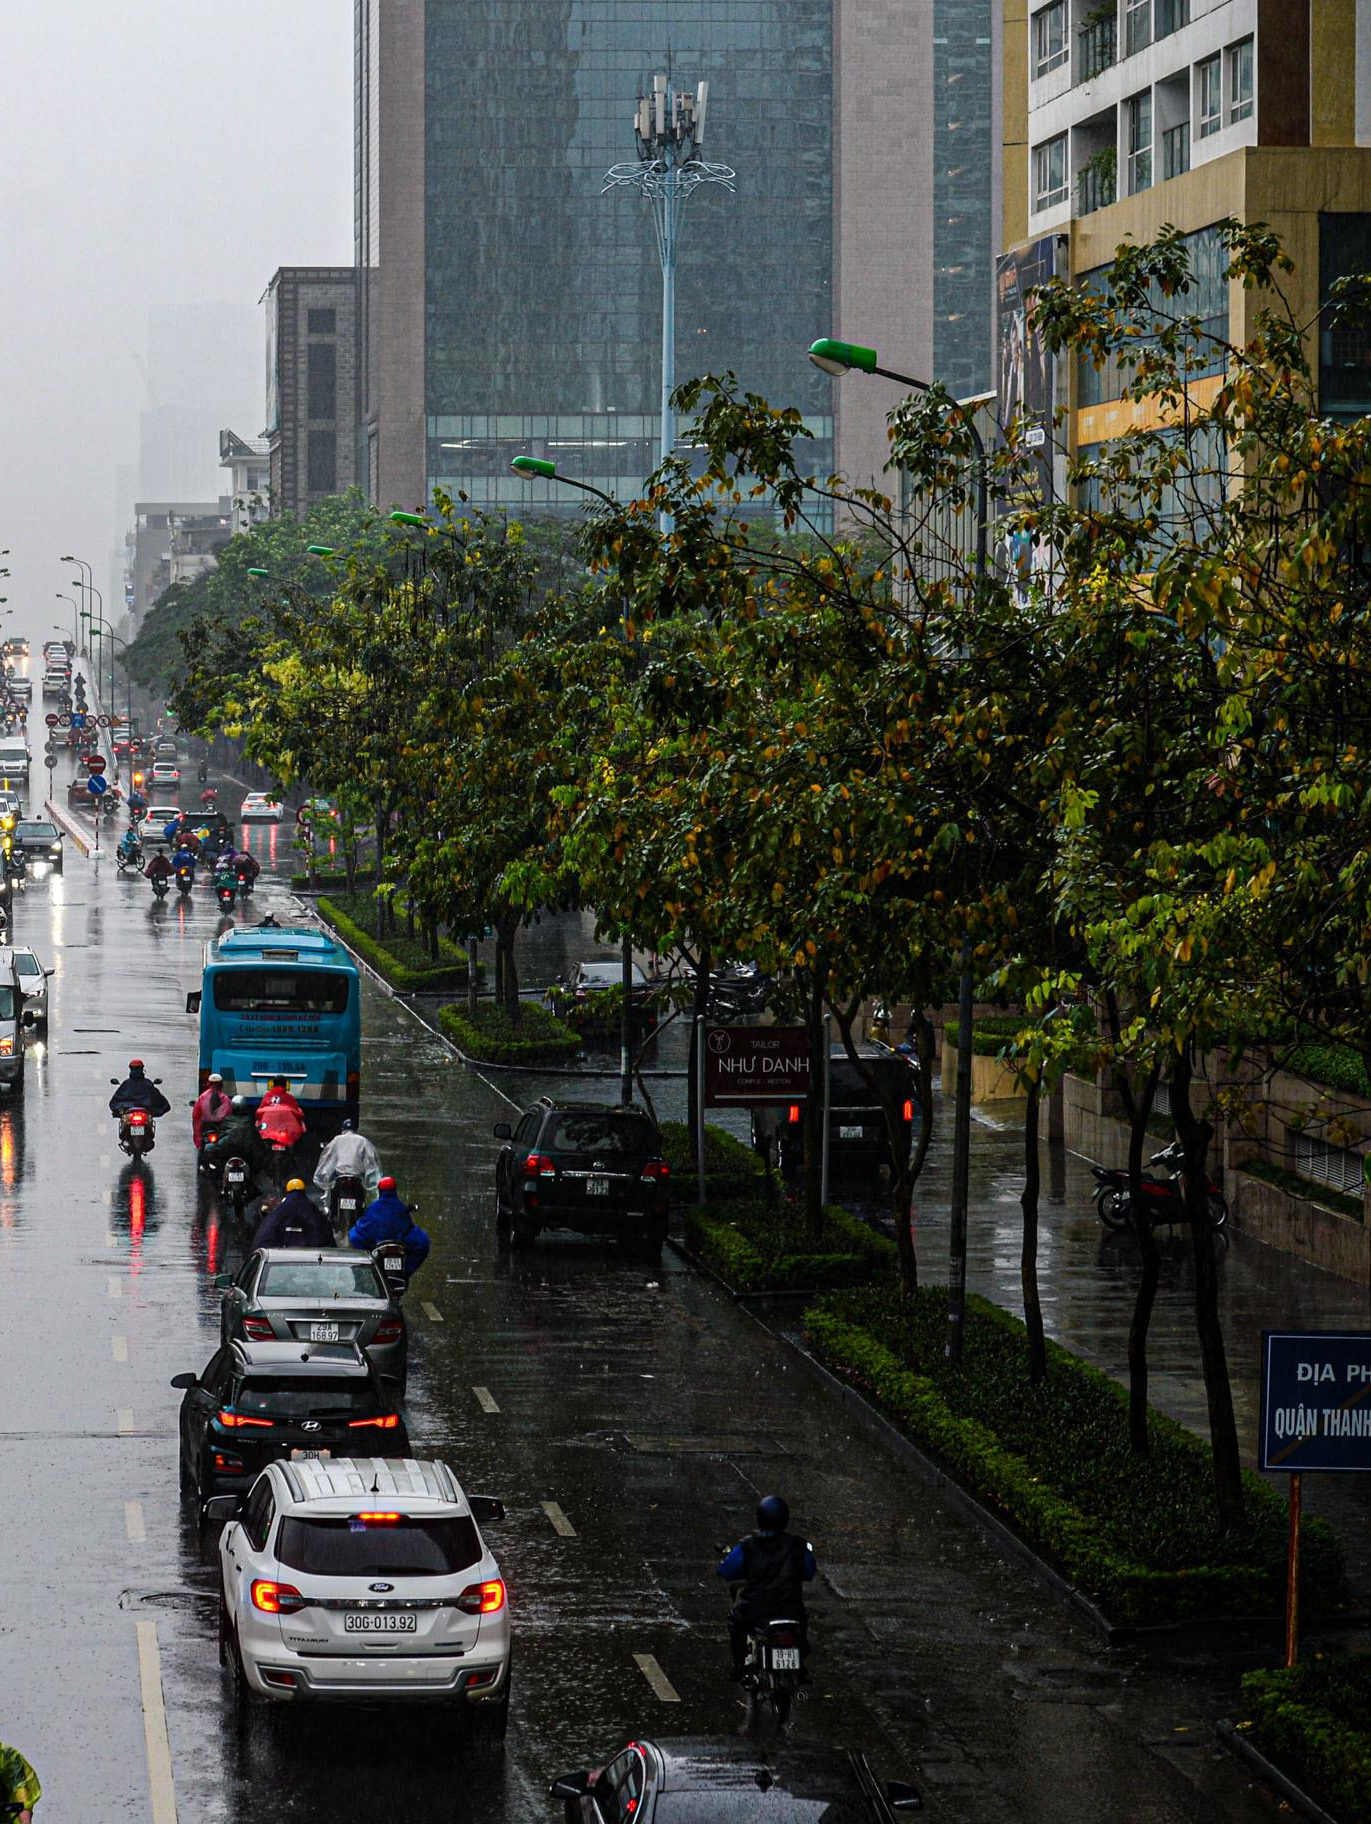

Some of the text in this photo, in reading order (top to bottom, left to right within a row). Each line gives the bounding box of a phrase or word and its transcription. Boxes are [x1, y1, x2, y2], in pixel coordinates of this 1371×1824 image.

[750, 1040, 781, 1048] TAILOR
[719, 1056, 810, 1073] NHƯ DANH
[1297, 1363, 1336, 1386] ĐỊA
[1275, 1403, 1371, 1440] QUẬN THANH
